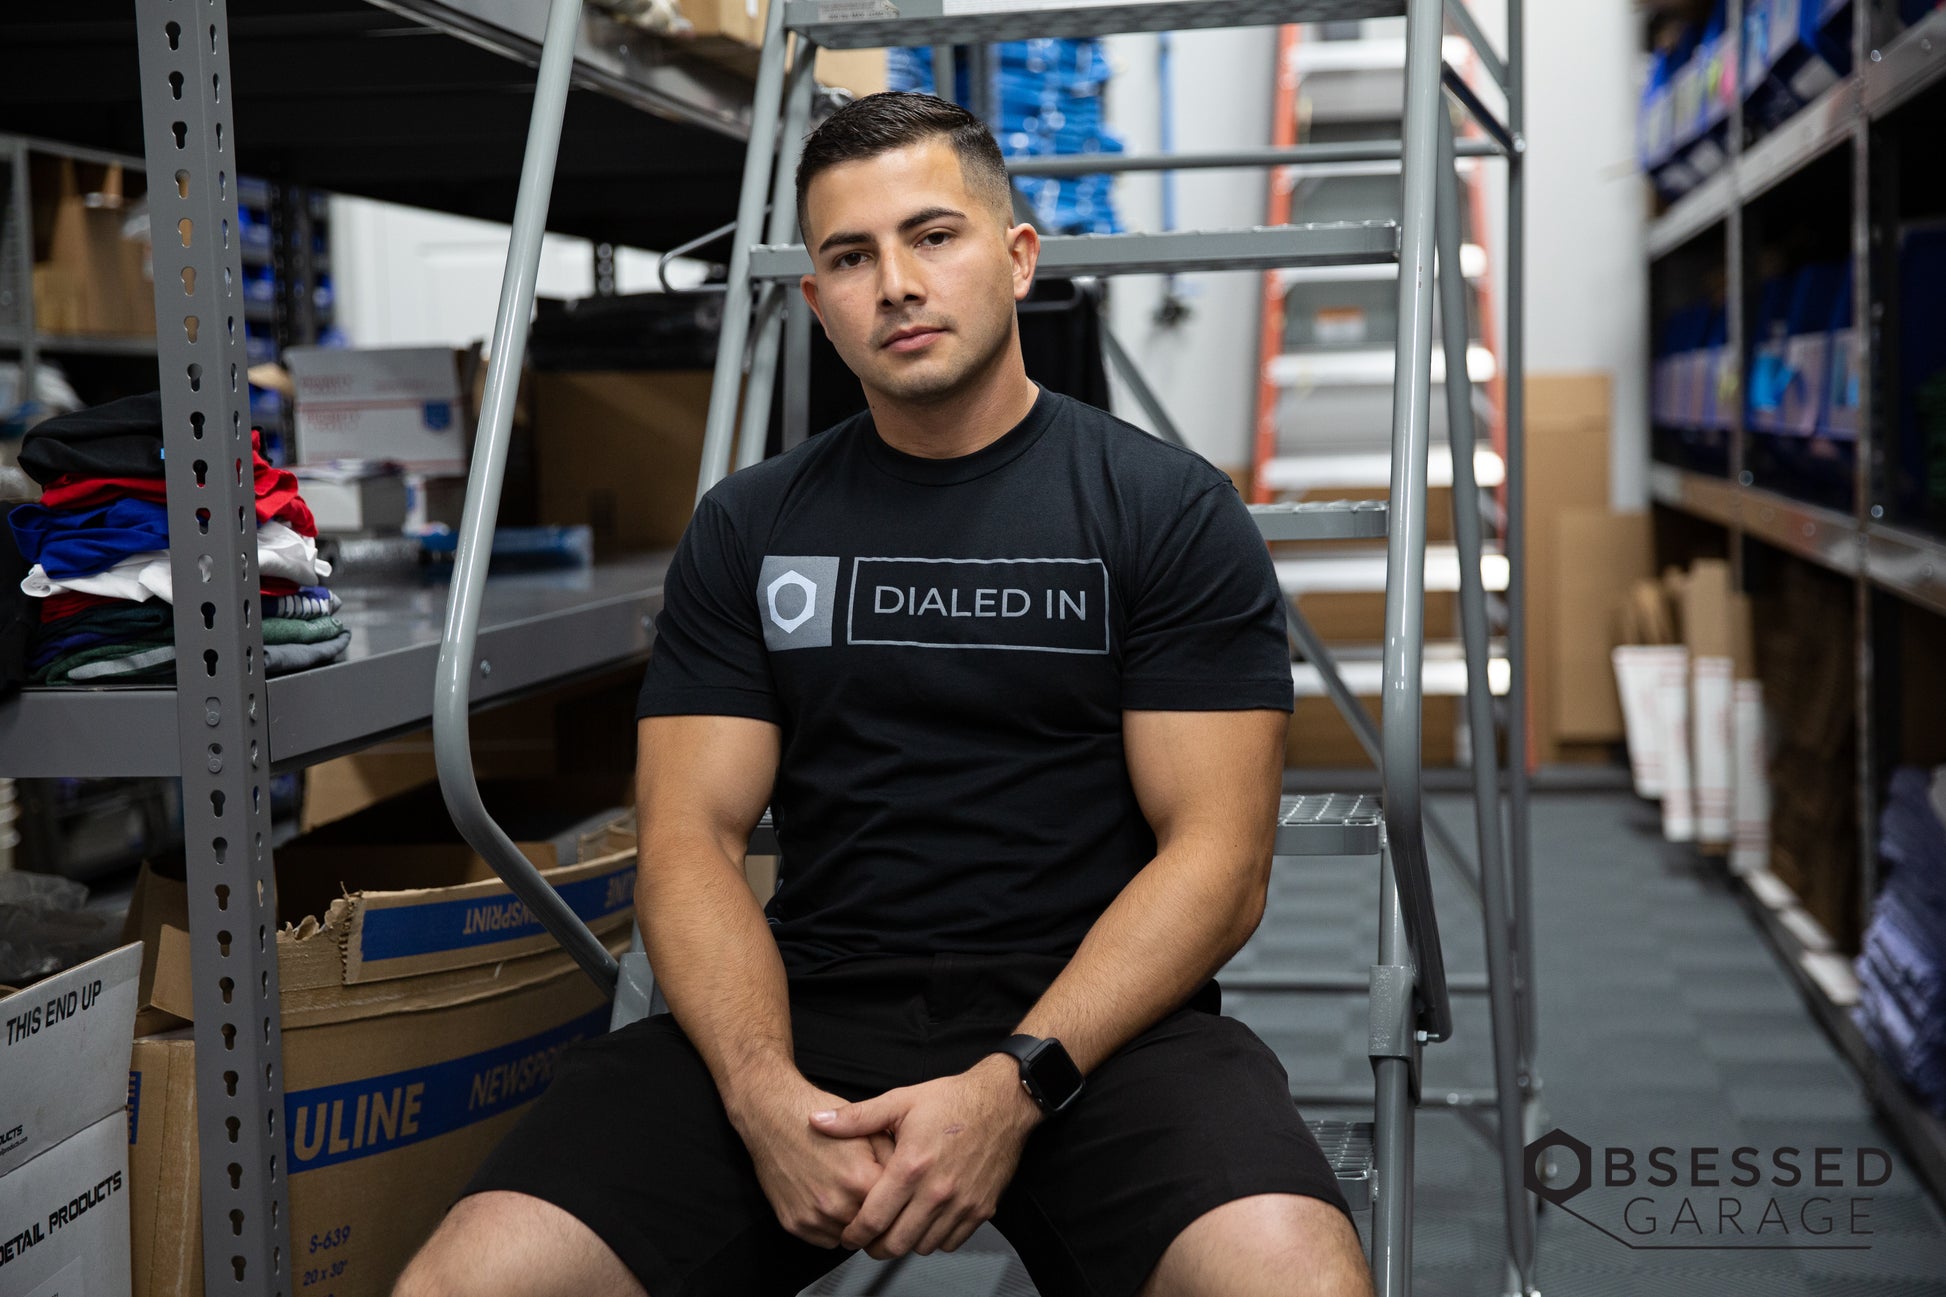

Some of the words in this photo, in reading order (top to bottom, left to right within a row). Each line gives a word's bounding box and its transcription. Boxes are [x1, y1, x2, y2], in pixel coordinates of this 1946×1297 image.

[874, 585, 1031, 618] DIALED
[1046, 589, 1086, 621] IN
[6, 1006, 42, 1046] THIS
[45, 990, 78, 1028] END
[81, 979, 102, 1011] UP
[294, 1082, 425, 1161] ULINE
[48, 1169, 122, 1235] PRODUCTS
[309, 1225, 351, 1254] S-639
[303, 1269, 319, 1287] 20
[320, 1269, 329, 1281] x
